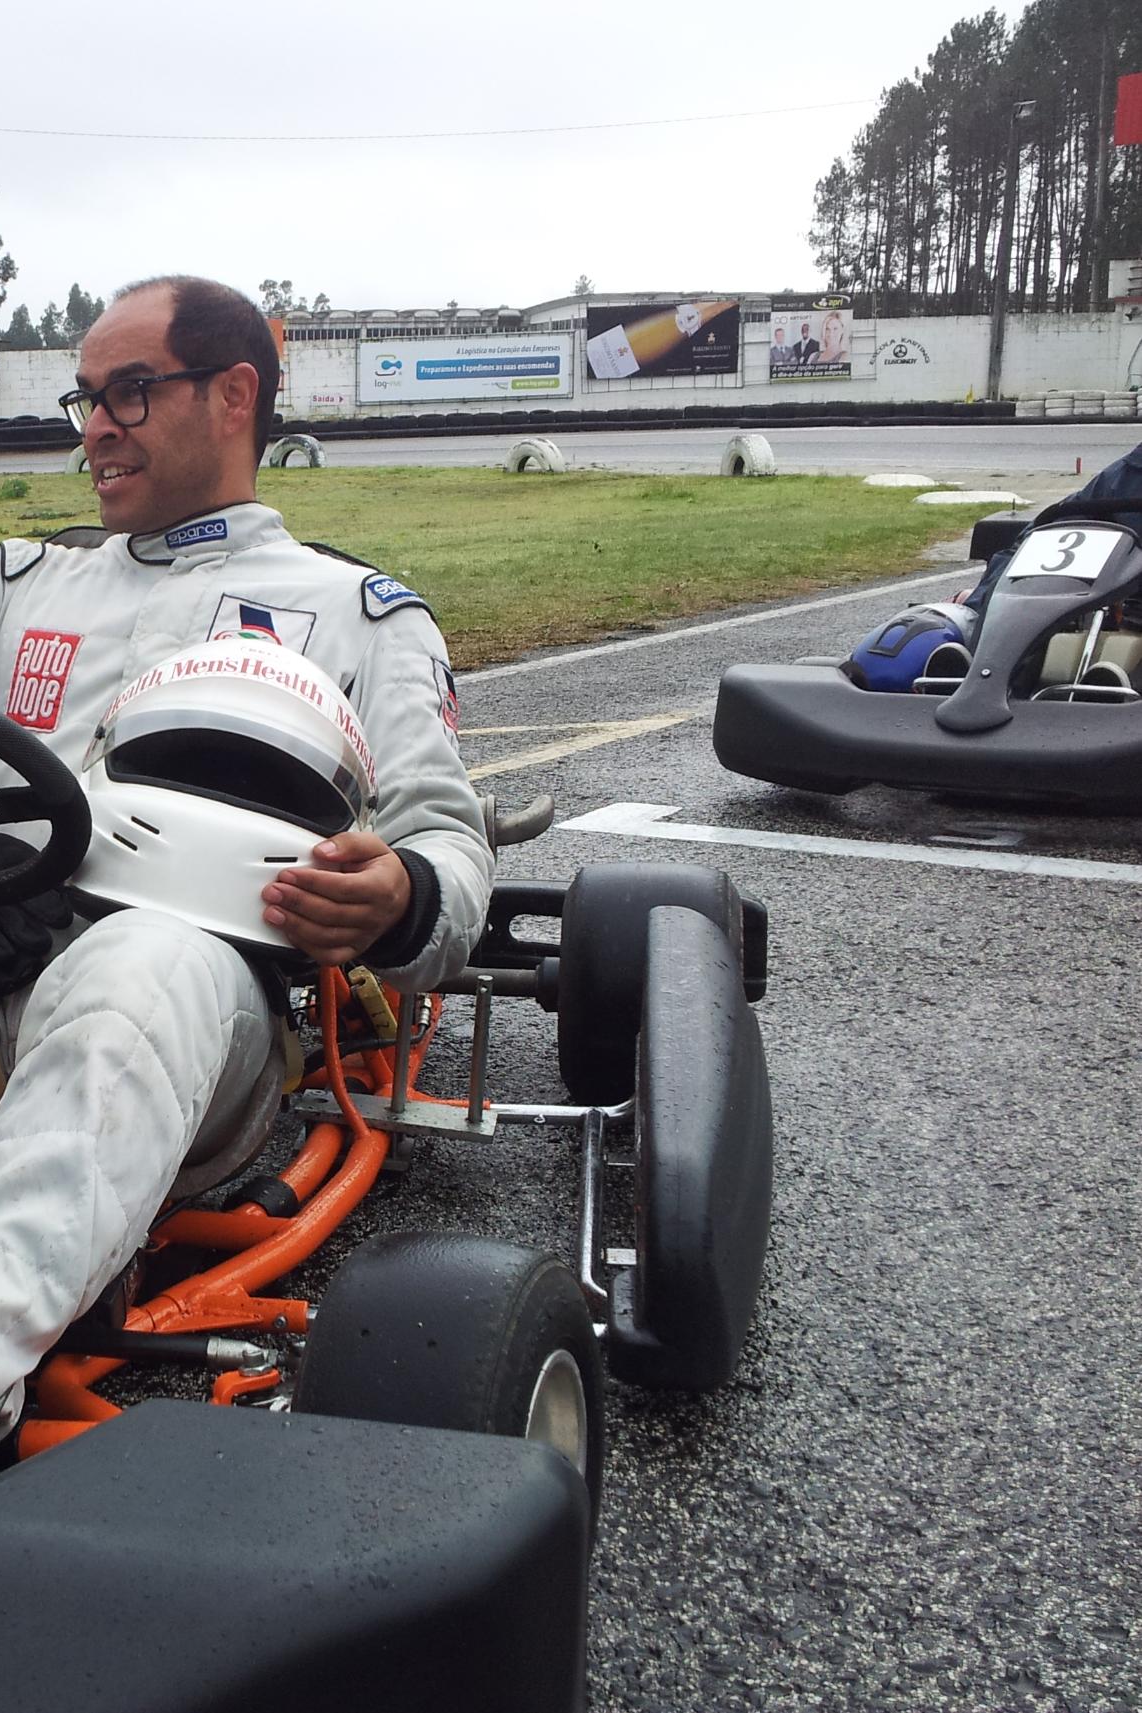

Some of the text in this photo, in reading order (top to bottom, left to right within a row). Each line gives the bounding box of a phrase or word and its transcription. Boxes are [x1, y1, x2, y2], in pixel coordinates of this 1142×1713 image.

[828, 297, 844, 308] apri
[901, 338, 930, 364] KARTING
[420, 366, 457, 375] Preparamos
[462, 363, 495, 373] Expedimos
[517, 361, 555, 370] encomendas
[168, 522, 225, 544] sparco
[1040, 531, 1087, 572] 3
[18, 635, 72, 677] auto
[9, 669, 61, 722] hoje
